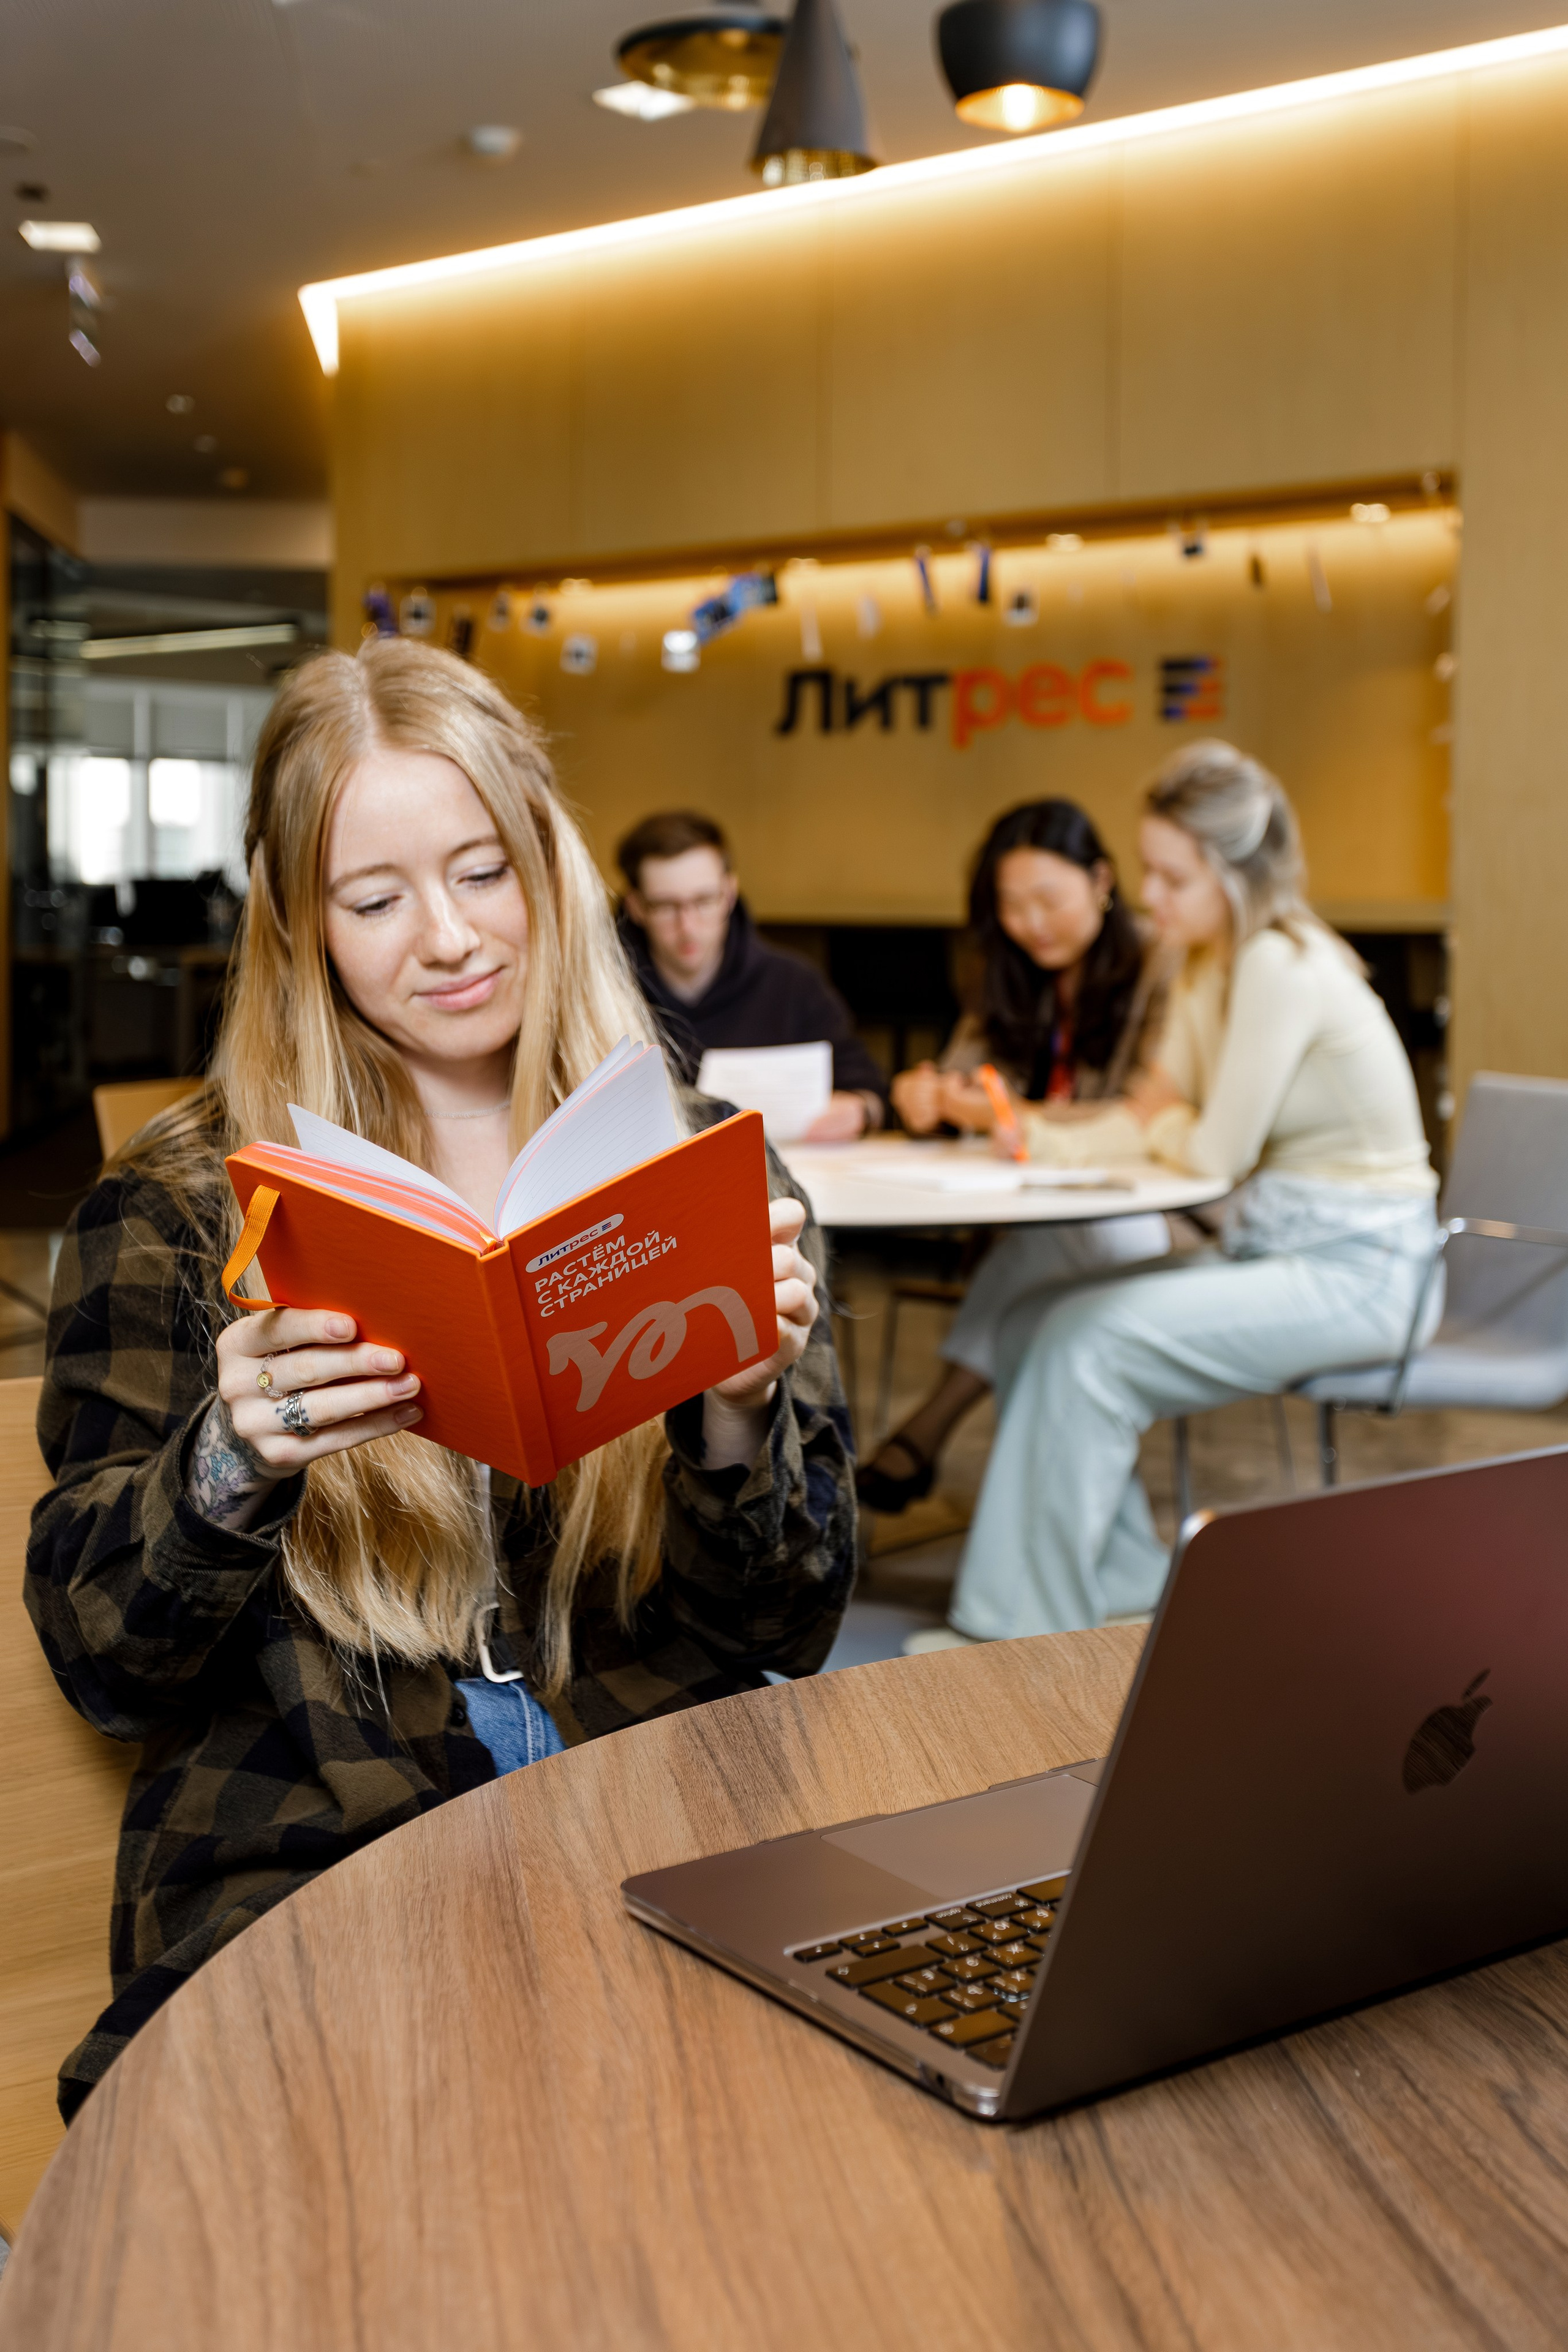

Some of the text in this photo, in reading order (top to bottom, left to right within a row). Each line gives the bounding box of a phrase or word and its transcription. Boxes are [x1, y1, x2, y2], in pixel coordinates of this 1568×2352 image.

[775, 658, 1134, 751] Литрес
[534, 1235, 626, 1293] РАСТЁМ
[537, 1230, 660, 1304] С КАЖДОЙ
[538, 1229, 598, 1266] Литрес
[540, 1235, 677, 1317] СТРАНИЦЕЙ
